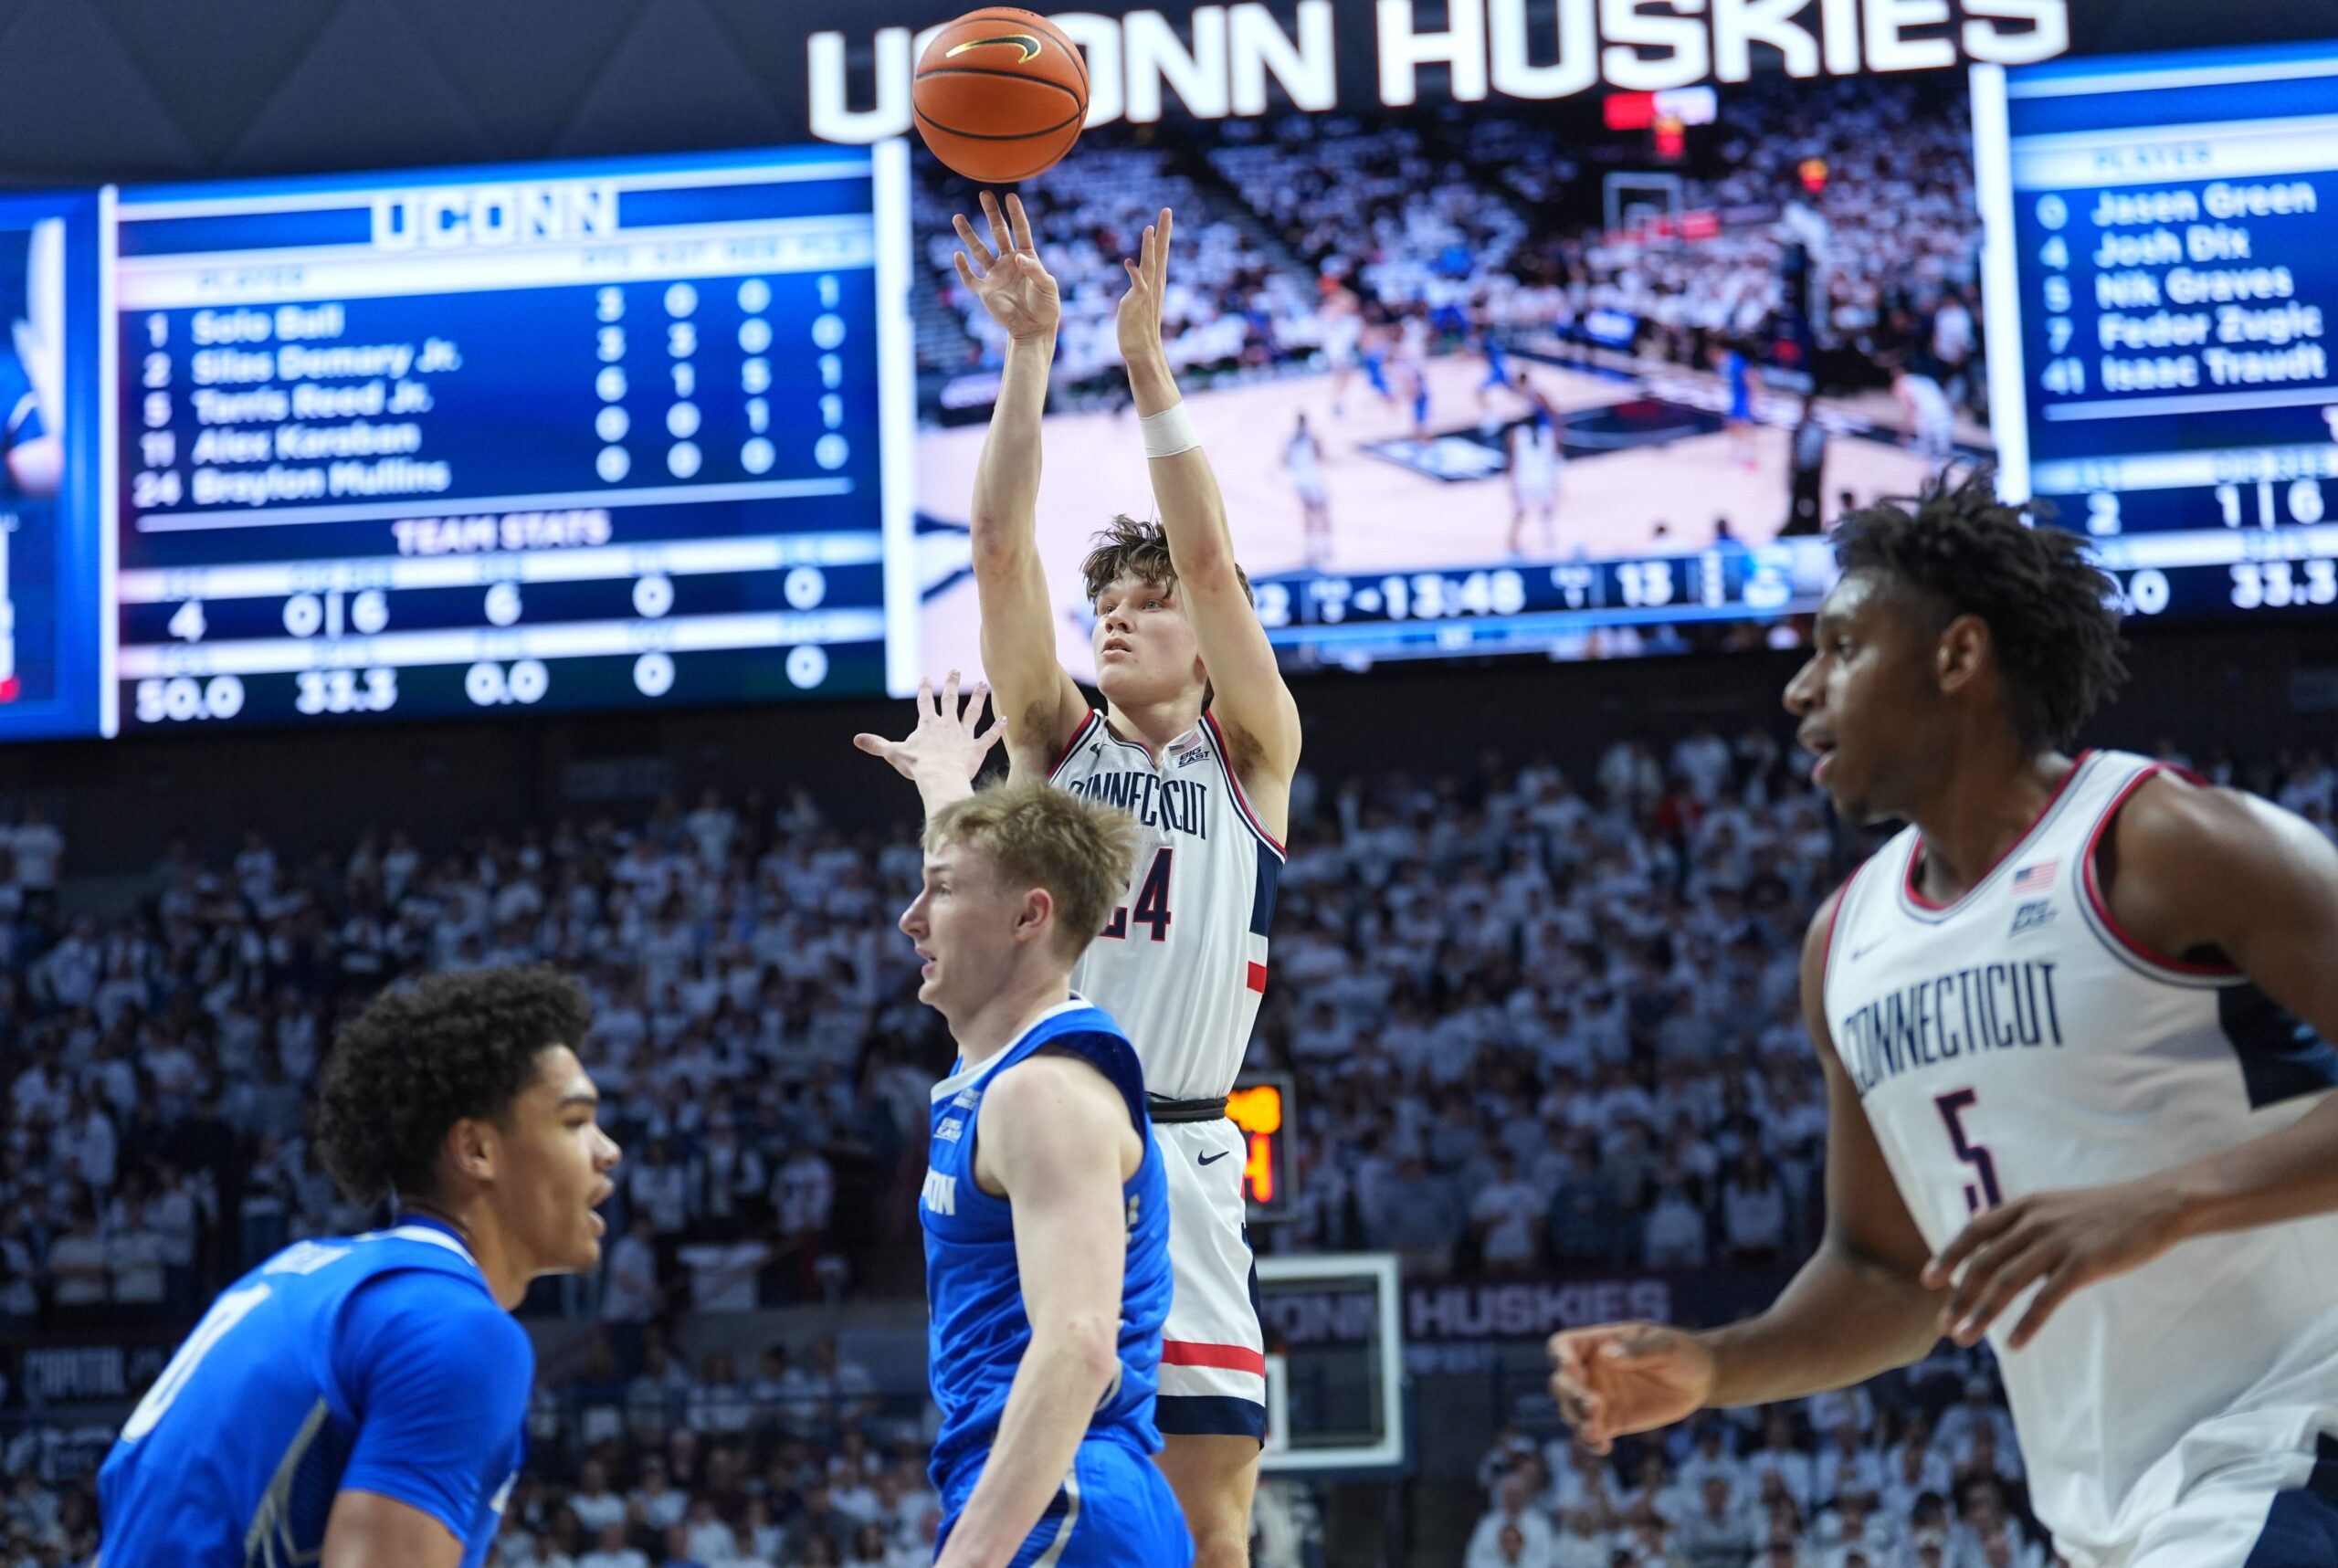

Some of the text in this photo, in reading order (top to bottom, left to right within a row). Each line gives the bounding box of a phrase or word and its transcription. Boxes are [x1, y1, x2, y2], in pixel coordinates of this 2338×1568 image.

[1374, 0, 2069, 107] HUSKIES
[372, 181, 618, 252] UCONN
[2203, 182, 2317, 219] Green
[2039, 222, 2251, 270] 4 Josh Dix
[147, 312, 169, 348] 1
[274, 301, 345, 341] Ball
[816, 274, 840, 310] 1
[2095, 269, 2162, 310] Nik
[2165, 266, 2294, 304] Graves
[142, 352, 172, 388] 2
[291, 378, 385, 419] Reed
[670, 362, 695, 398] 1
[817, 353, 843, 389] 1
[2041, 357, 2085, 395] 41
[140, 429, 176, 468] 11
[192, 426, 272, 465] Alex
[275, 418, 422, 459] Karaban
[744, 396, 770, 434] 1
[818, 393, 844, 429] 1
[132, 469, 182, 508] 24
[192, 463, 326, 507] Braylon
[328, 457, 451, 497] Mullins
[391, 508, 612, 556] TEAM STATS
[168, 598, 207, 642] 4
[484, 582, 521, 626] 6
[632, 574, 675, 619] 0
[784, 565, 827, 611] 0
[1616, 561, 1673, 607] 13
[2229, 558, 2337, 608] 33.3
[136, 643, 828, 722] 50.0 33.3 0.0 0 0
[1178, 751, 1210, 765] EAST
[1180, 746, 1202, 760] BIG
[1844, 962, 2064, 1095] CONNECTICUT
[1409, 1280, 1669, 1336] HUSKIES
